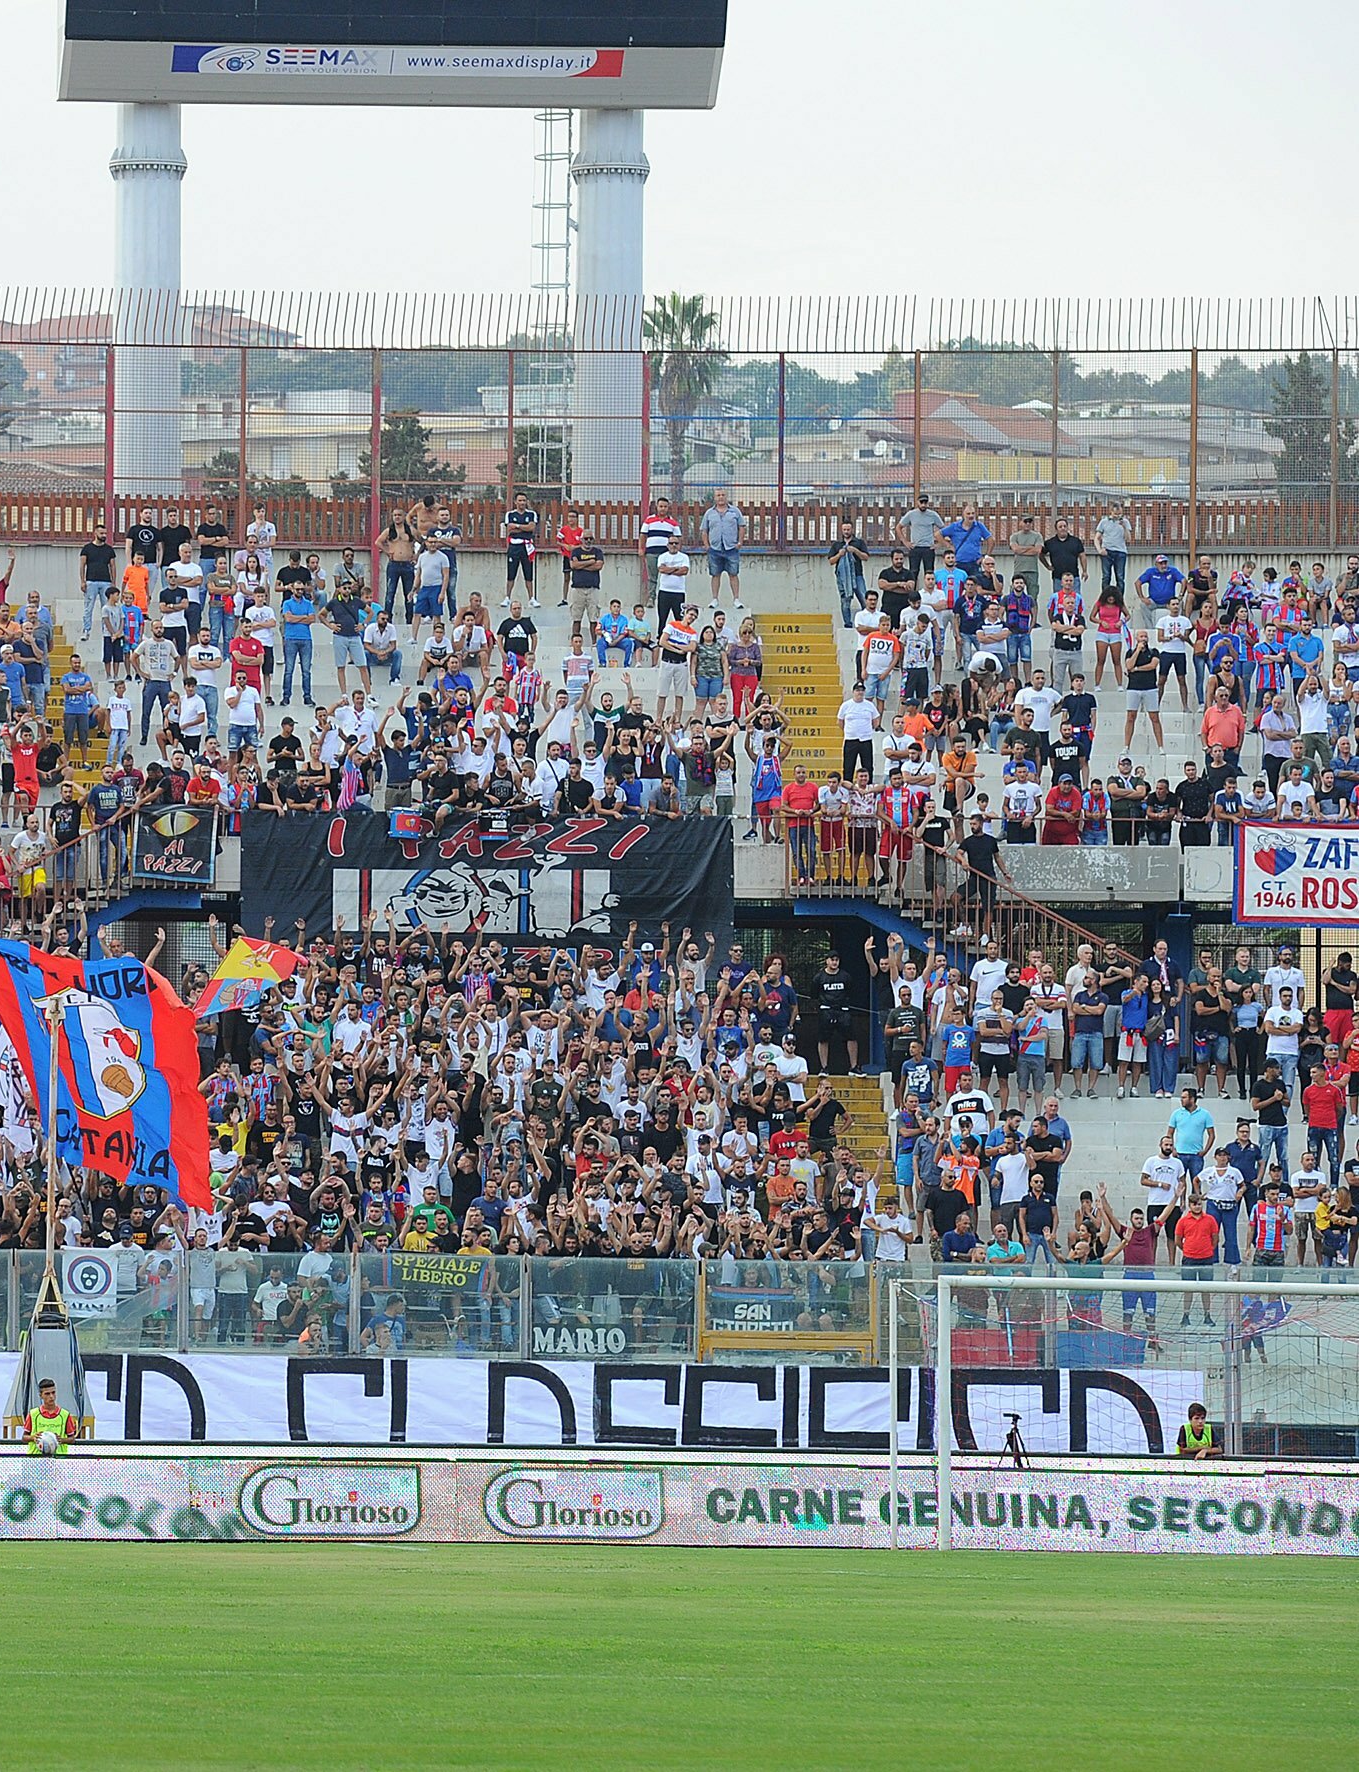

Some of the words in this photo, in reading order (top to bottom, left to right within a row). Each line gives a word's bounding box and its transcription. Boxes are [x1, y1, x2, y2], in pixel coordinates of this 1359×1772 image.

[265, 48, 378, 66] SEEMAX
[406, 52, 592, 71] www.seemaxdisplay.it
[265, 66, 307, 74] DISPLAY
[343, 67, 378, 75] VISION
[870, 640, 892, 651] BOY
[784, 707, 804, 715] FILA
[1054, 746, 1078, 758] TOUCH
[164, 838, 185, 855] AI
[143, 854, 203, 874] PAZZI
[1253, 892, 1296, 908] 1946
[392, 1253, 482, 1274] SPEZIALE
[402, 1267, 467, 1287] LIBERO
[734, 1303, 772, 1321] SAN
[532, 1327, 627, 1354] MARIO
[253, 1474, 410, 1527] Glorioso
[496, 1478, 653, 1529] Glorioso
[705, 1487, 867, 1526] CARNE
[878, 1490, 1111, 1538] GENUINA,
[1128, 1495, 1359, 1538] SECOND
